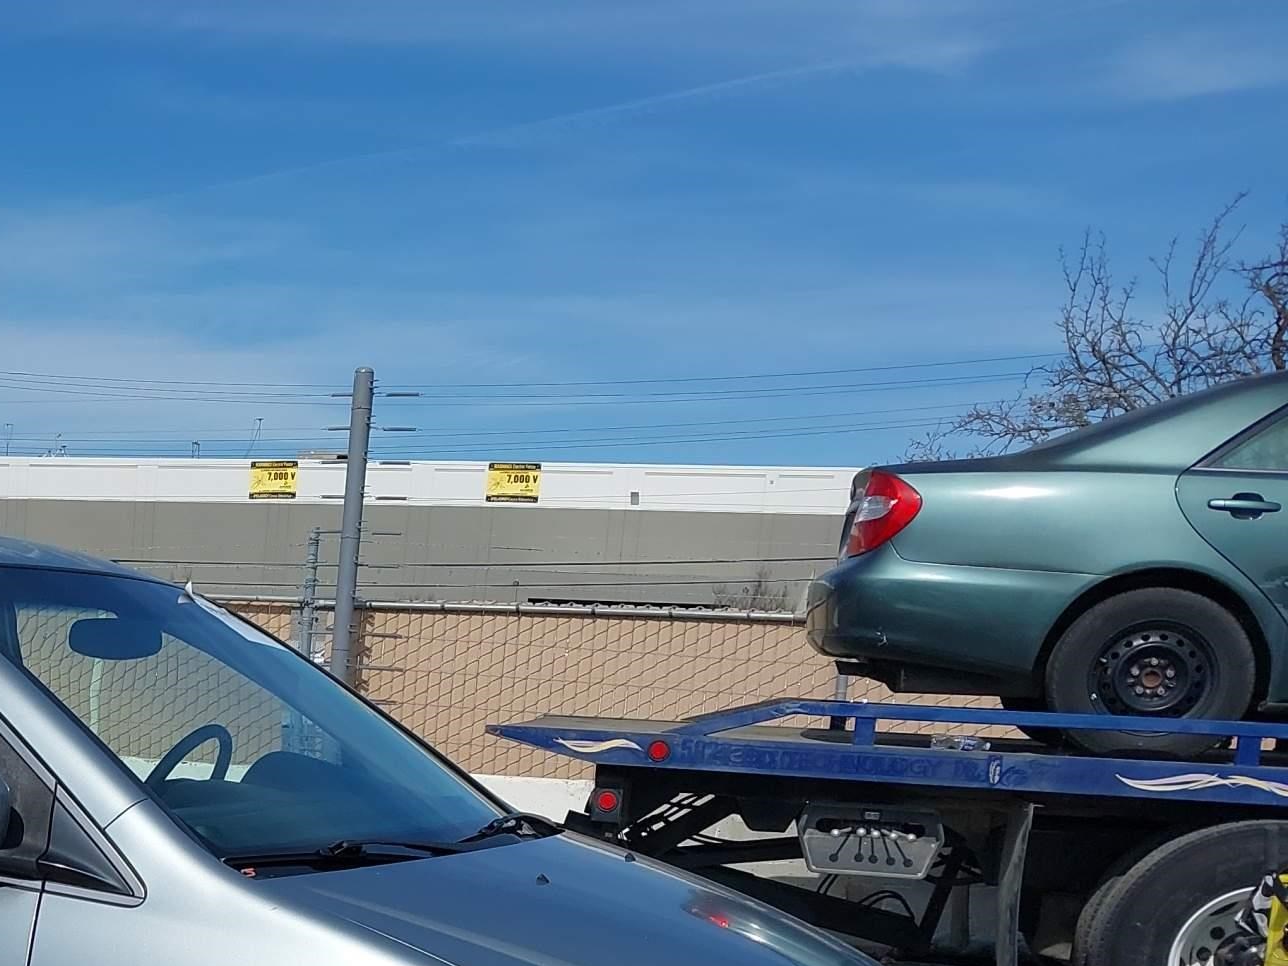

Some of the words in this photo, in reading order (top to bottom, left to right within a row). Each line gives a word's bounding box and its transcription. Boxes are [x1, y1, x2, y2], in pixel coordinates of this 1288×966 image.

[267, 471, 289, 482] 7,000
[290, 471, 296, 481] V
[506, 474, 531, 484] 7,000
[532, 474, 538, 484] V
